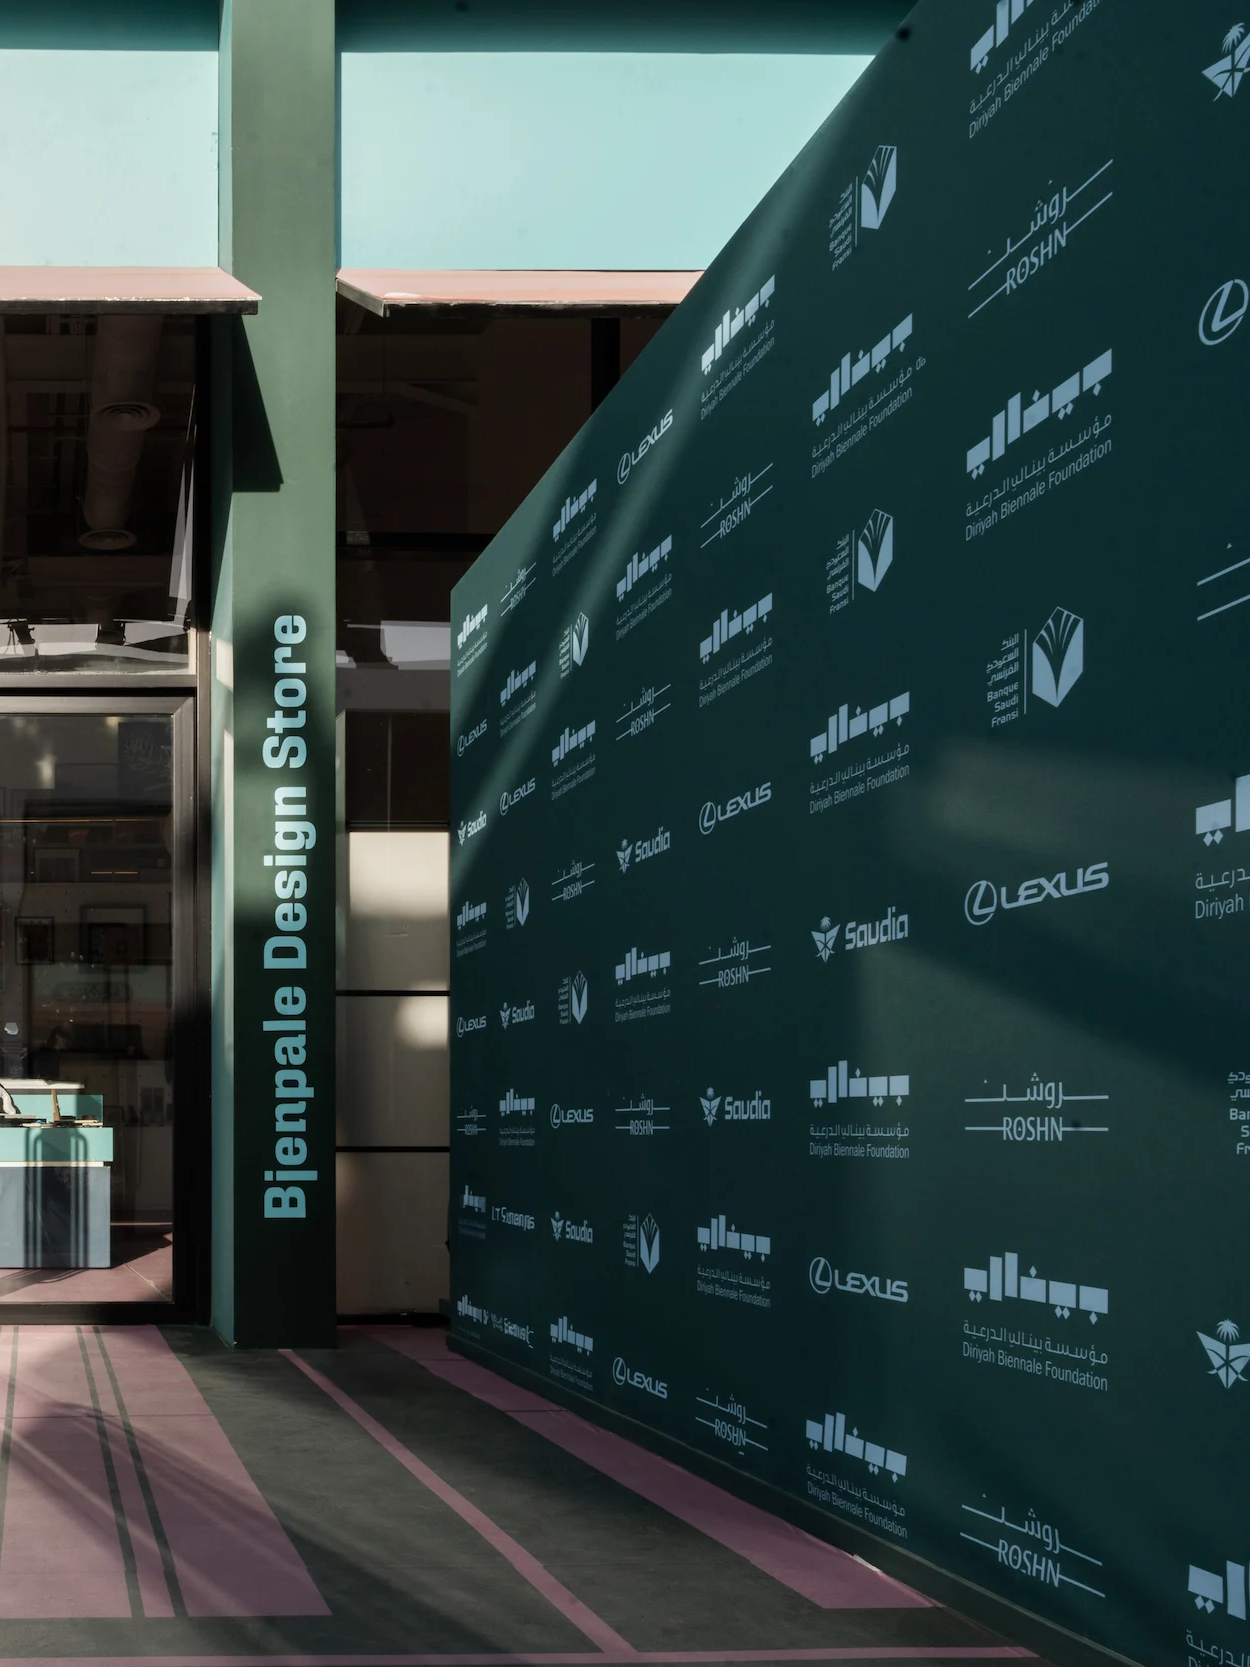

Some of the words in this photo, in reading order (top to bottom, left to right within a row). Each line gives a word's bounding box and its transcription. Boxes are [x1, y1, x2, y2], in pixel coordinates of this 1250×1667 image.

[969, 97, 1002, 140] Diriyah
[1004, 47, 1050, 103] Biennale
[1006, 221, 1068, 296] ROSHN
[631, 408, 674, 466] LEXUS
[811, 450, 835, 479] Diriyah
[835, 424, 868, 459] Biennale
[868, 387, 913, 431] Foundation
[966, 509, 998, 541] Diriyah
[1000, 481, 1046, 520] Biennale
[1049, 439, 1113, 490] Foundation
[719, 496, 752, 539] ROSHN
[262, 614, 307, 769] Store
[986, 681, 1019, 703] Banque
[994, 693, 1019, 713] Saudi
[991, 707, 1019, 728] Fransi
[508, 776, 536, 806] LEXUS
[717, 781, 772, 822] LEXUS
[809, 794, 833, 814] Diriyah
[833, 782, 865, 804] Biennale
[866, 764, 910, 792] Foundation
[634, 825, 671, 863] Saudia
[263, 787, 317, 970] Design
[1000, 862, 1110, 910] LEXUS
[1195, 893, 1244, 920] Diriyah
[845, 905, 909, 951] Saudia
[718, 965, 749, 988] ROSHN
[724, 1090, 771, 1120] Saudia
[965, 1072, 1064, 1109] روشن
[561, 1108, 595, 1123] LEXUS
[1002, 1116, 1063, 1141] ROSHN
[809, 1142, 833, 1159] Diriyah
[833, 1142, 865, 1157] Biennale
[866, 1143, 910, 1159] Foundation
[565, 1219, 594, 1244] Saudia
[834, 1269, 909, 1303] LEXUS
[626, 1367, 668, 1400] LEXUS
[962, 1341, 995, 1364] Diriyah
[997, 1350, 1043, 1375] Biennale
[1045, 1360, 1109, 1392] Foundation
[807, 1481, 831, 1503] Diriyah
[831, 1491, 863, 1518] Biennale
[864, 1507, 908, 1539] Foundation
[998, 1539, 1061, 1588] ROSHN
